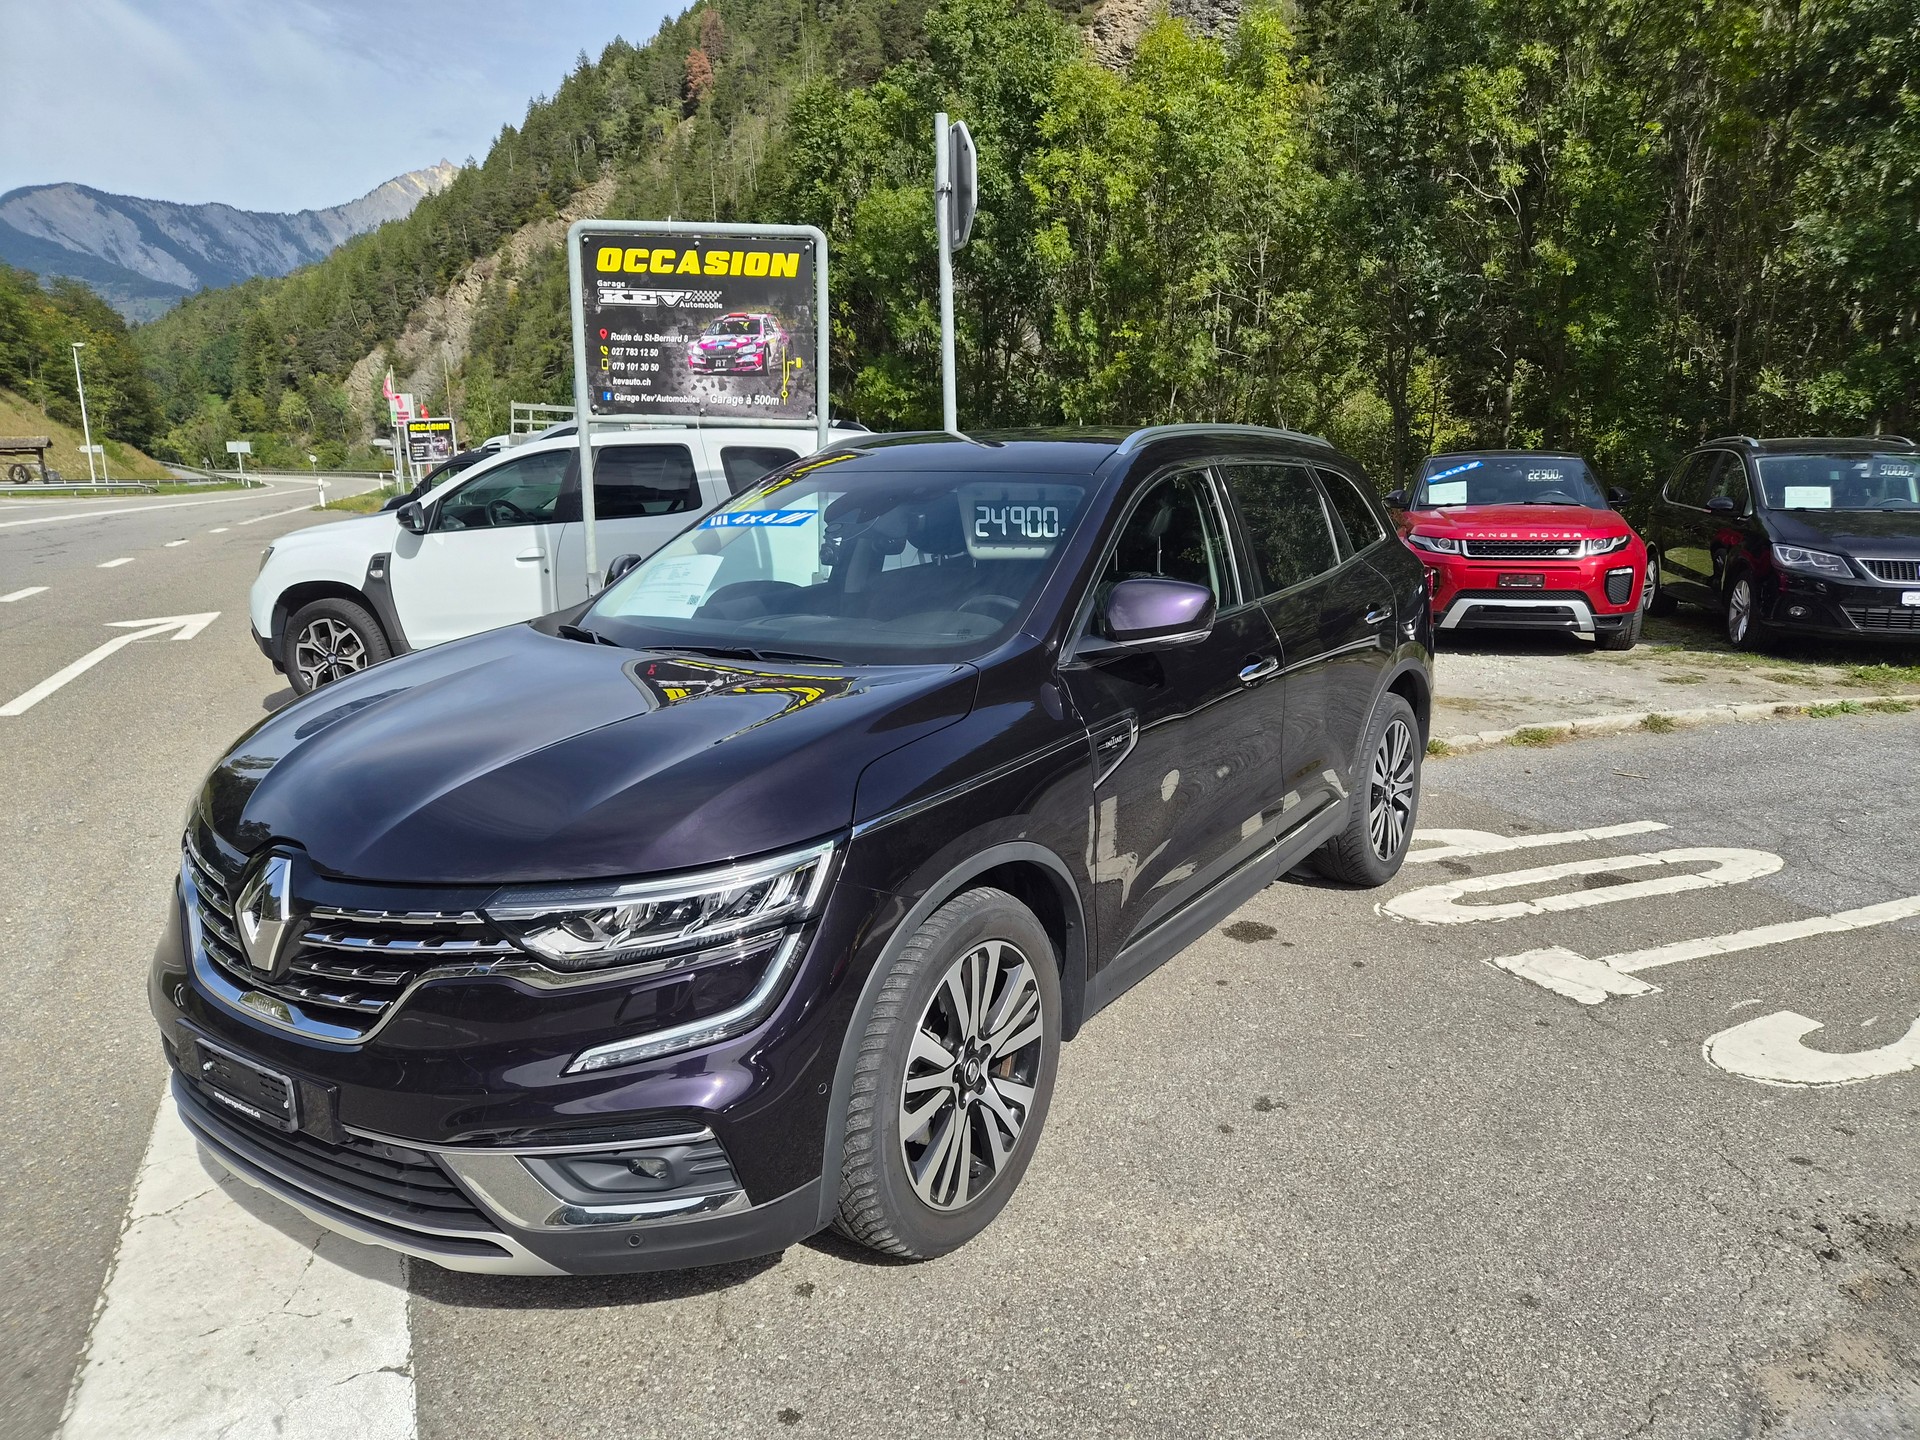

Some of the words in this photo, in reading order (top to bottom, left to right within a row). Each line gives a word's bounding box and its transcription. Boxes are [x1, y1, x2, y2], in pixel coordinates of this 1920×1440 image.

[596, 247, 800, 278] OCCASION
[596, 280, 626, 289] Garage
[679, 301, 723, 309] Automobile
[610, 332, 632, 341] Route
[633, 333, 643, 342] du
[644, 333, 682, 343] St-Bernard
[683, 334, 689, 342] 8
[611, 347, 624, 356] 027
[625, 347, 639, 356] 783
[640, 348, 649, 356] 12
[649, 348, 659, 357] 50
[611, 362, 625, 371] 079
[626, 362, 639, 371] 101
[640, 363, 649, 371] 30
[650, 363, 660, 372] 50
[612, 376, 652, 386] kevauto.ch
[614, 392, 640, 403] Garage
[710, 393, 744, 406] Garage
[744, 394, 752, 405] à
[754, 395, 780, 406] 500m
[409, 422, 450, 431] OCCASION
[731, 512, 778, 524] 4x4
